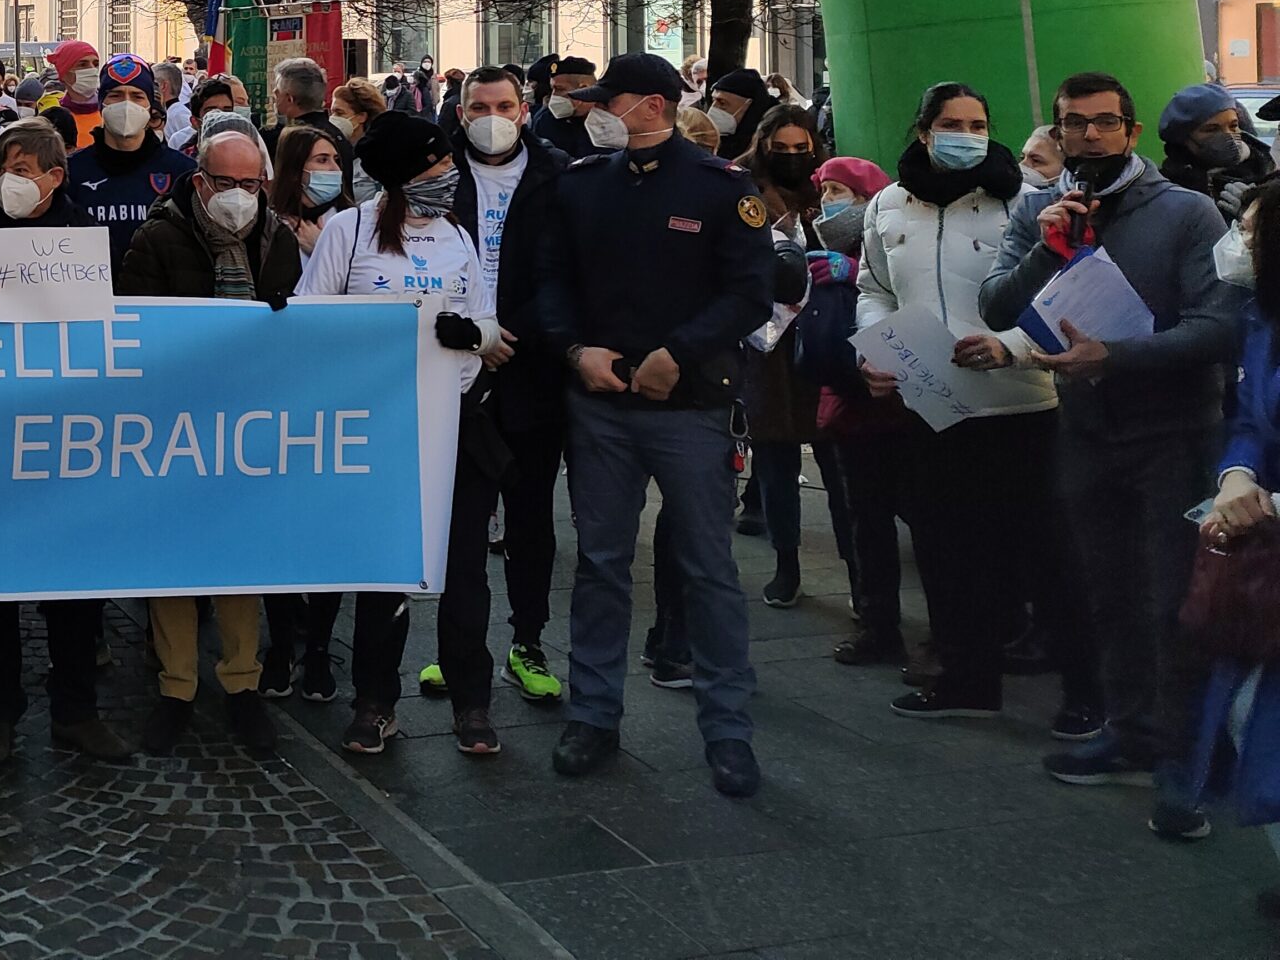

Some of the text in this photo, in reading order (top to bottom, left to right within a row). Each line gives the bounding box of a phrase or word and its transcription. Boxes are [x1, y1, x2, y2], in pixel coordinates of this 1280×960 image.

[486, 210, 506, 220] RU
[32, 238, 73, 256] WE
[404, 275, 443, 289] RUN
[12, 410, 370, 480] EBRAICHE
